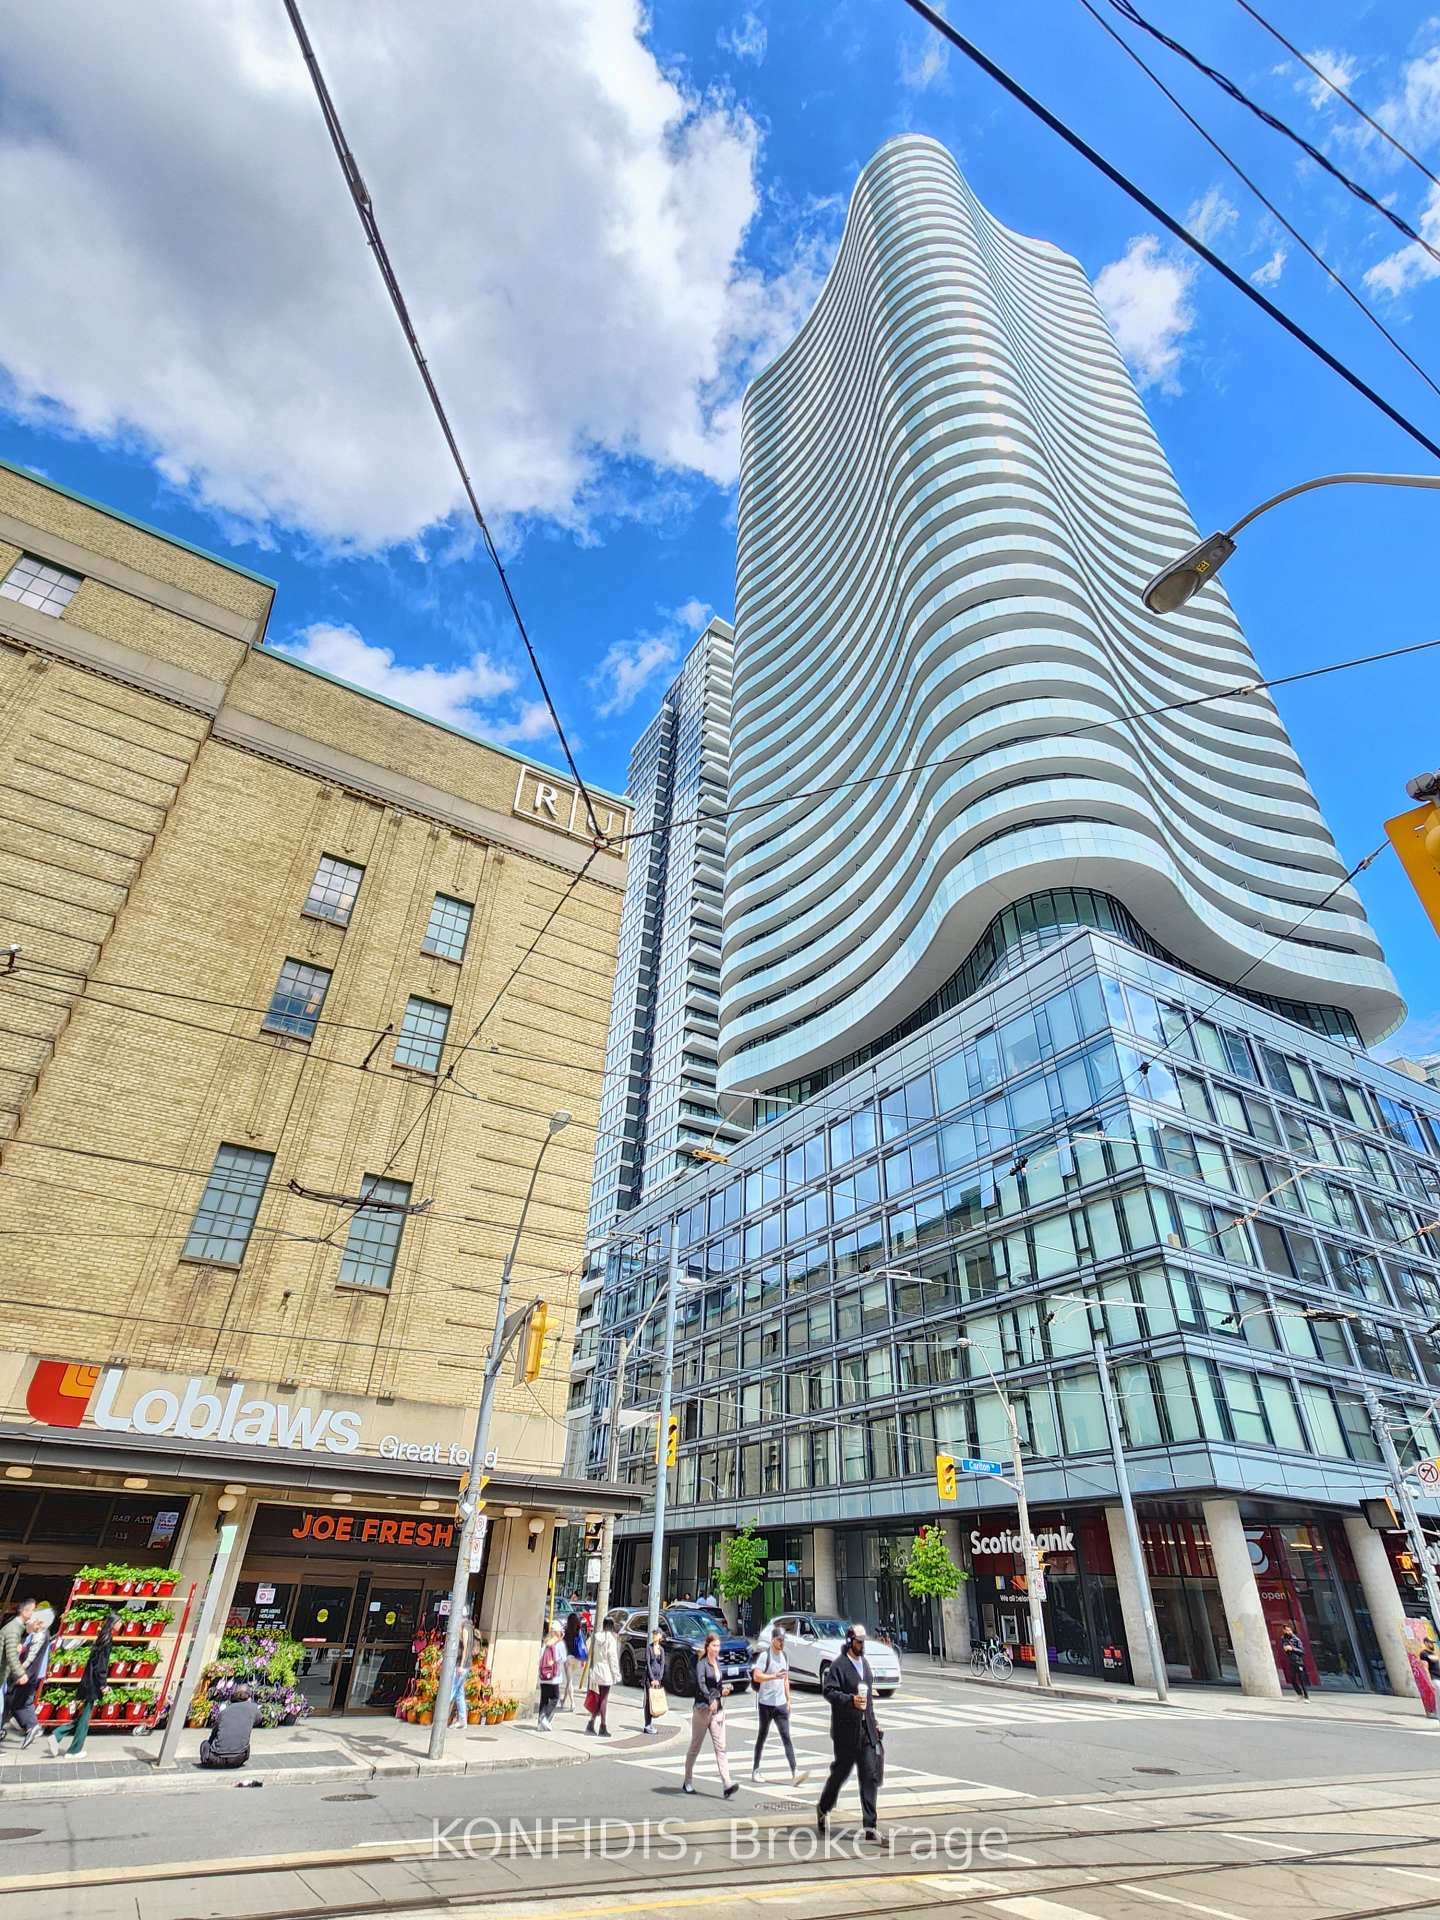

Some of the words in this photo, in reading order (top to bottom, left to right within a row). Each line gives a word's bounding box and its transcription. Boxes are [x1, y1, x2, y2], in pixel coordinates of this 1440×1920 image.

[93, 1368, 361, 1455] Loblaws
[379, 1434, 442, 1464] Great
[448, 1442, 499, 1468] fod
[292, 1514, 354, 1541] JOE
[362, 1518, 453, 1547] FRESH
